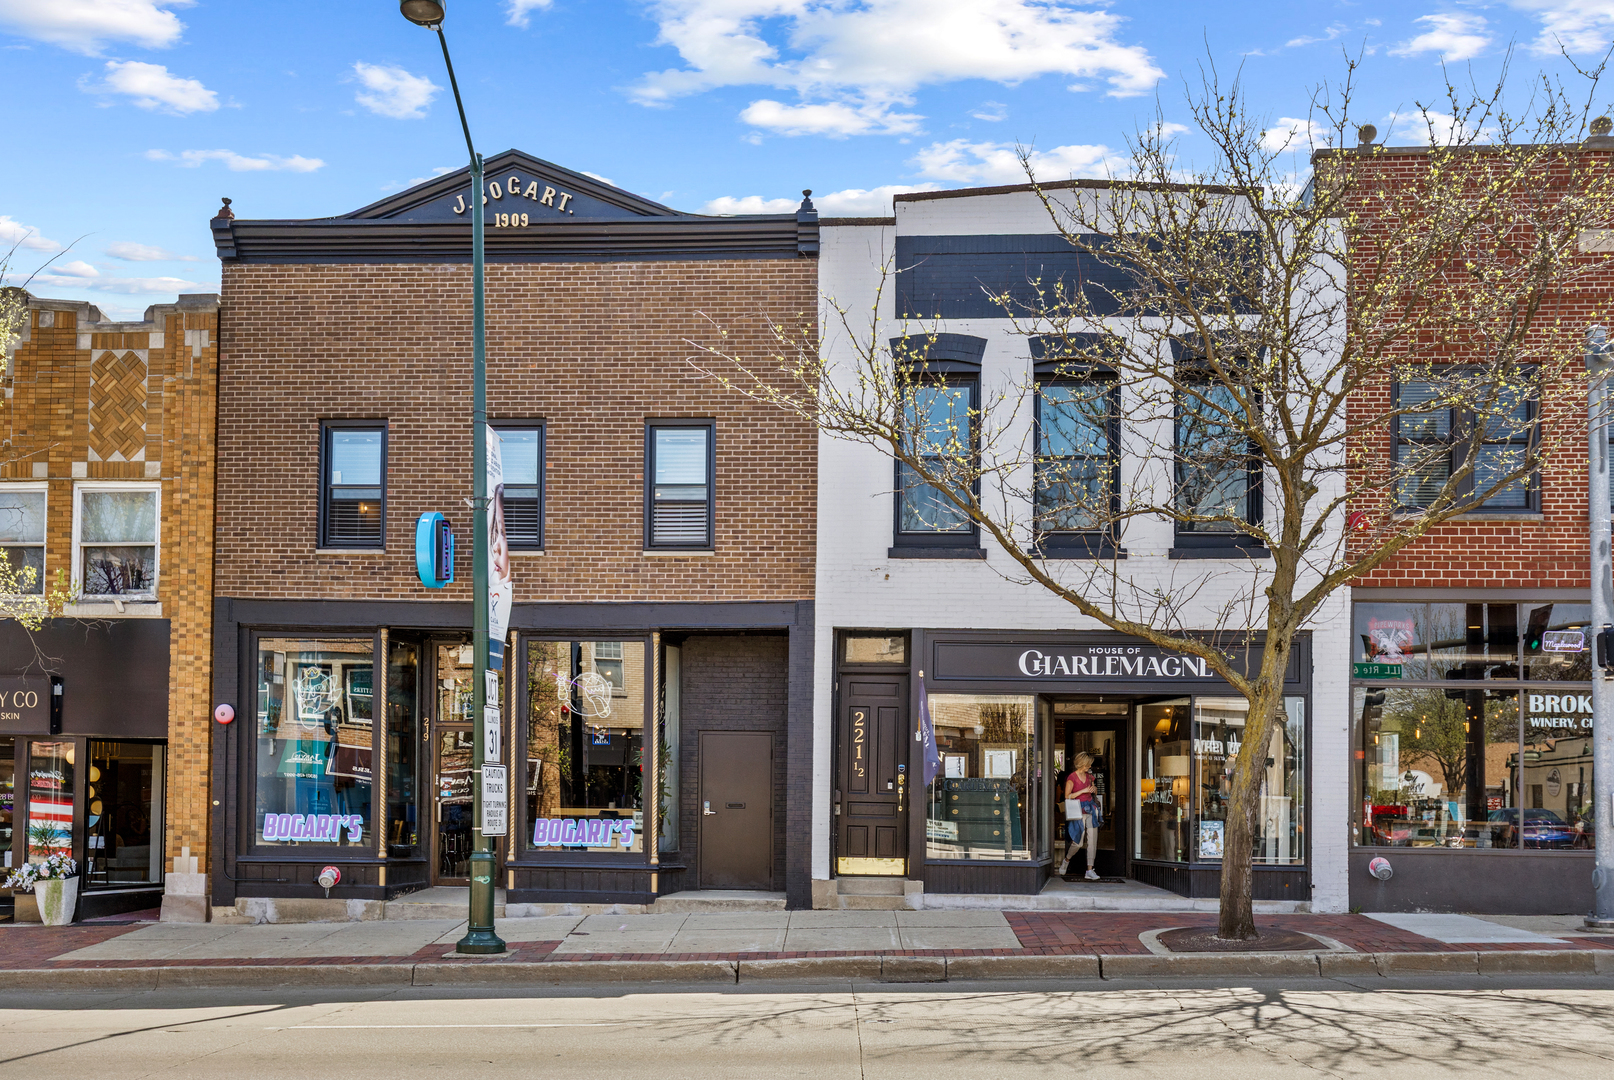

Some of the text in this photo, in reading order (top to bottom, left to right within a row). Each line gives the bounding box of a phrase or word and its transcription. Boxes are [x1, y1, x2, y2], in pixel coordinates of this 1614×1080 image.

[482, 176, 573, 214] OGART.
[494, 212, 529, 227] 1909
[1374, 620, 1410, 630] PIPEWORKS
[1089, 647, 1141, 655] HOUSE OF
[1545, 640, 1582, 651] Maplewood
[487, 677, 498, 702] JCT
[13, 690, 39, 708] CO
[0, 712, 20, 720] SKIN
[1530, 717, 1578, 729] WINERY,
[488, 729, 498, 755] 31
[485, 768, 504, 779] CAUTION
[486, 783, 504, 793] TRUCKS
[493, 800, 507, 809] TURNING
[262, 813, 364, 843] BOGART'S
[533, 818, 636, 848] BOGART'S
